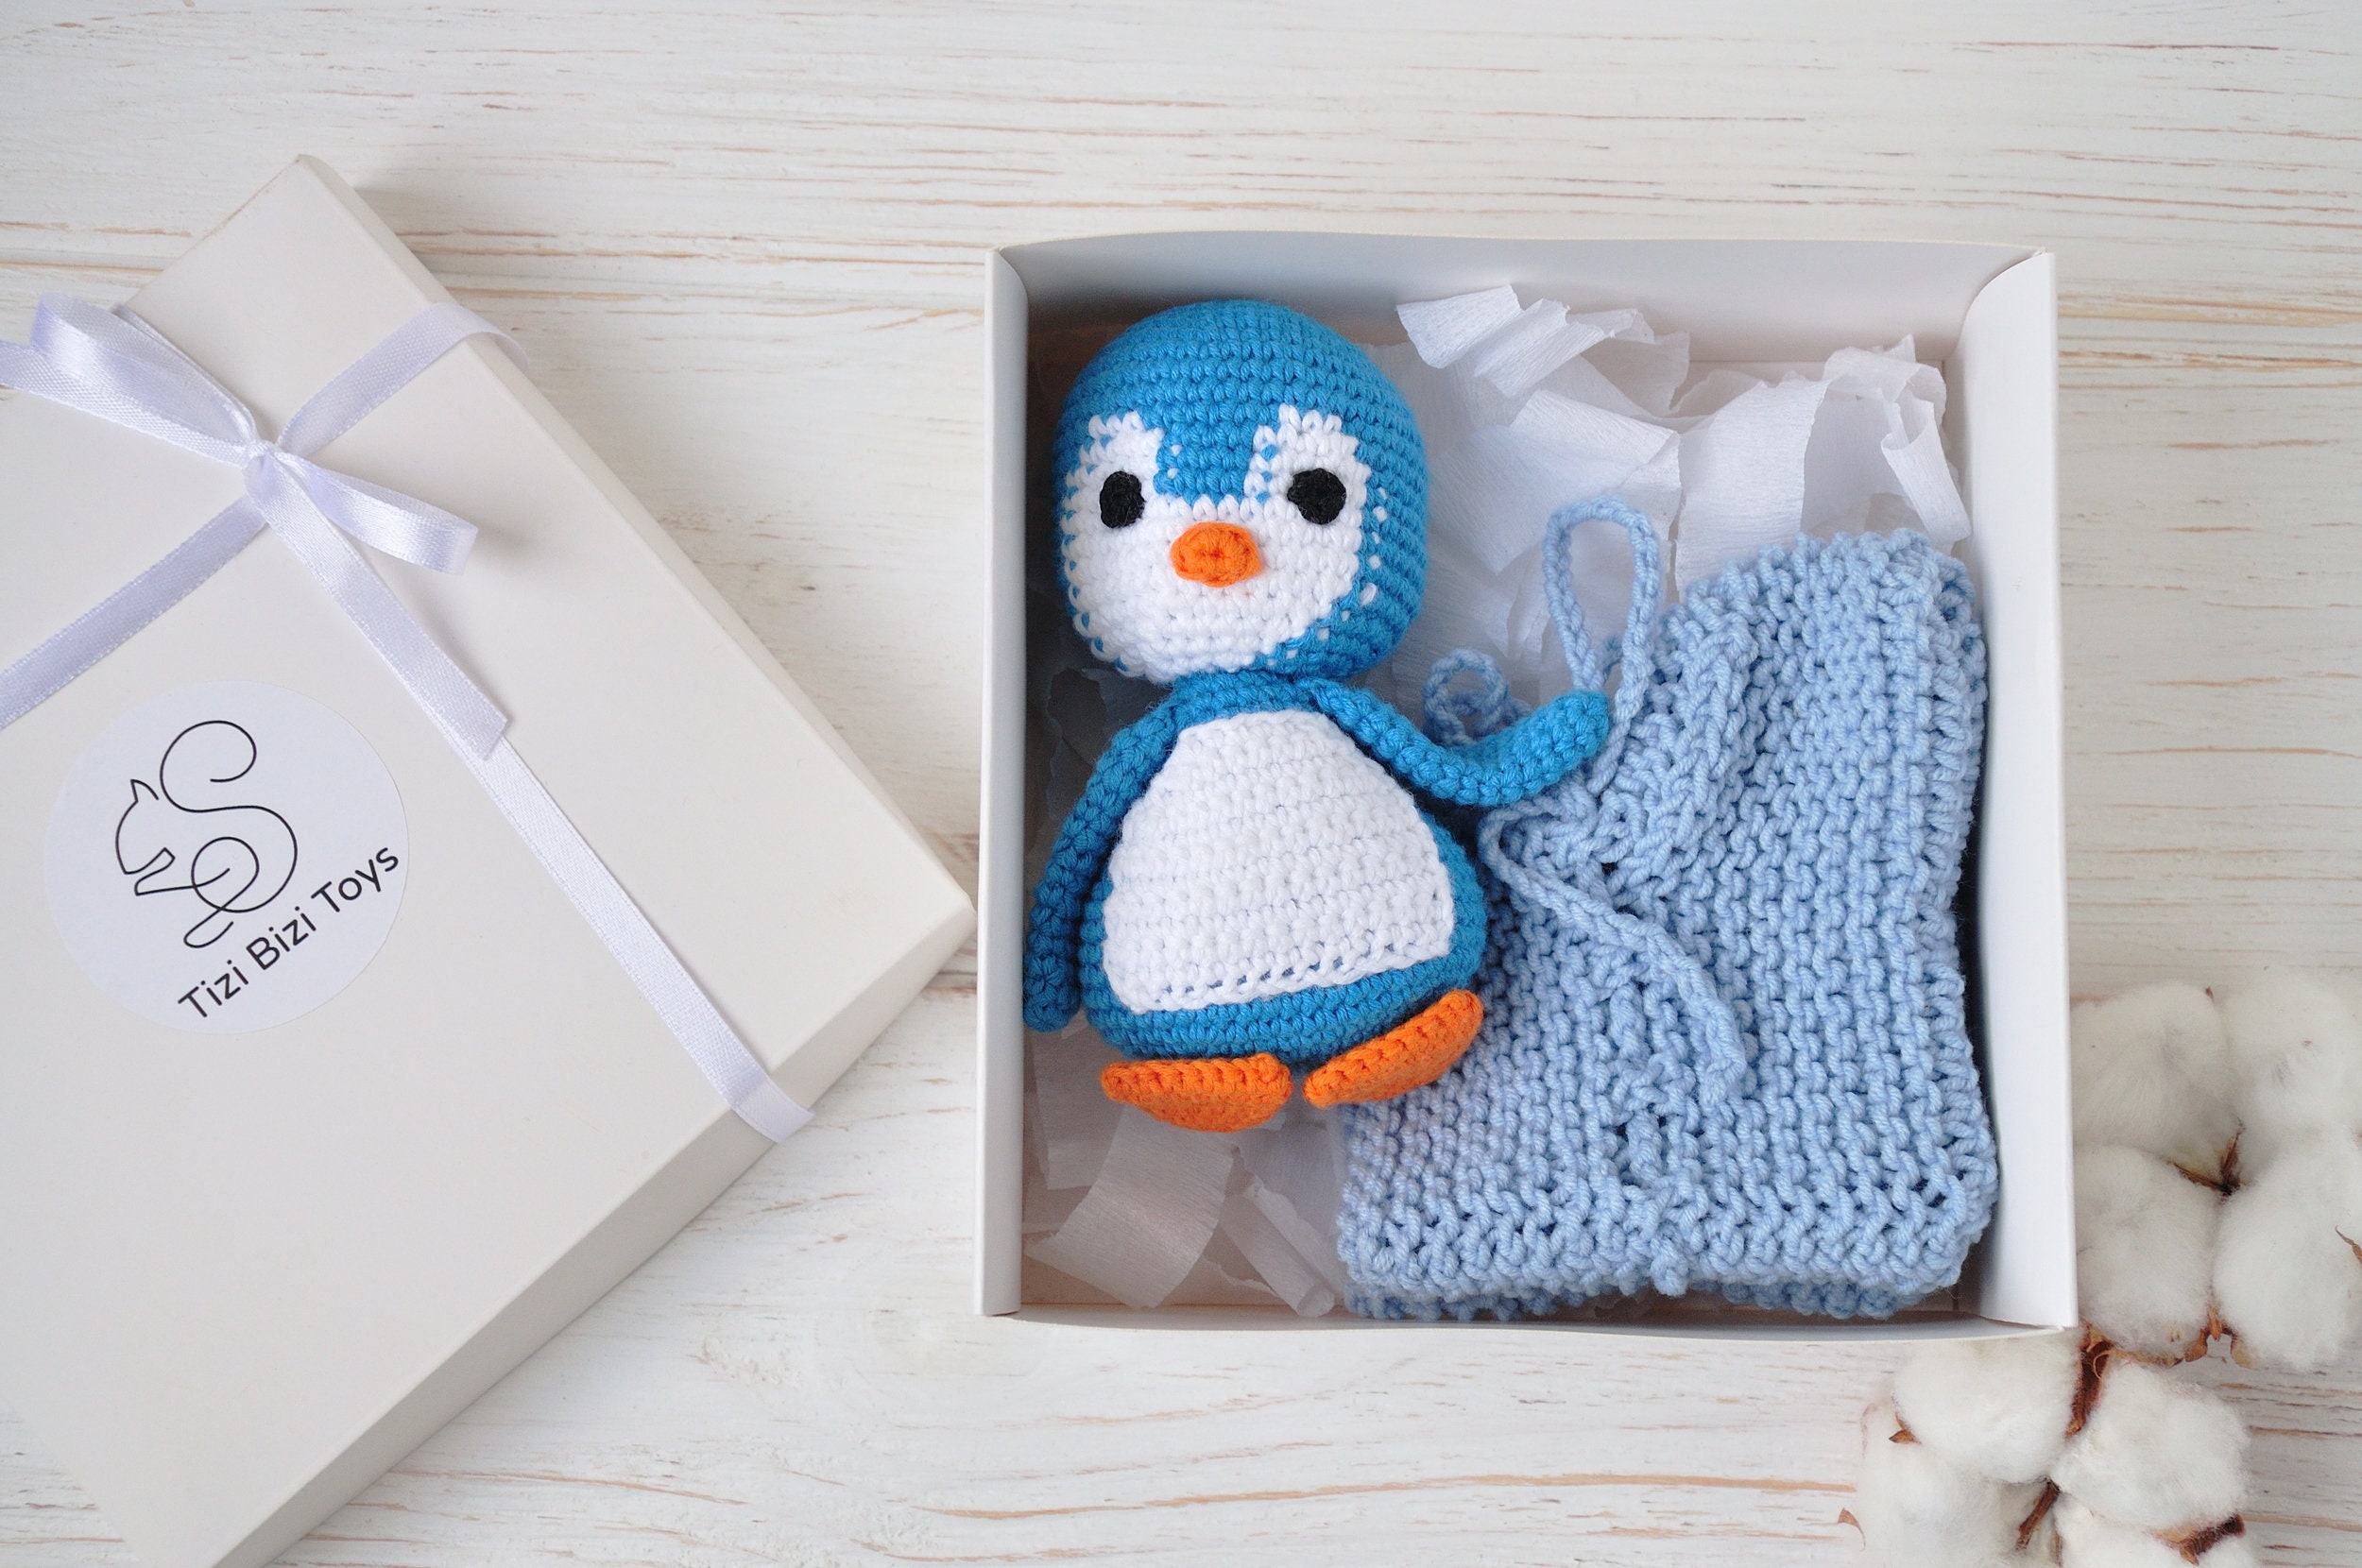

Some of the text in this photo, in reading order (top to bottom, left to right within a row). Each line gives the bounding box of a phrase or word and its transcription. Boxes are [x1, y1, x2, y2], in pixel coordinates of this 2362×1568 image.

[178, 847, 399, 1017] Tizi Bizi Toys
